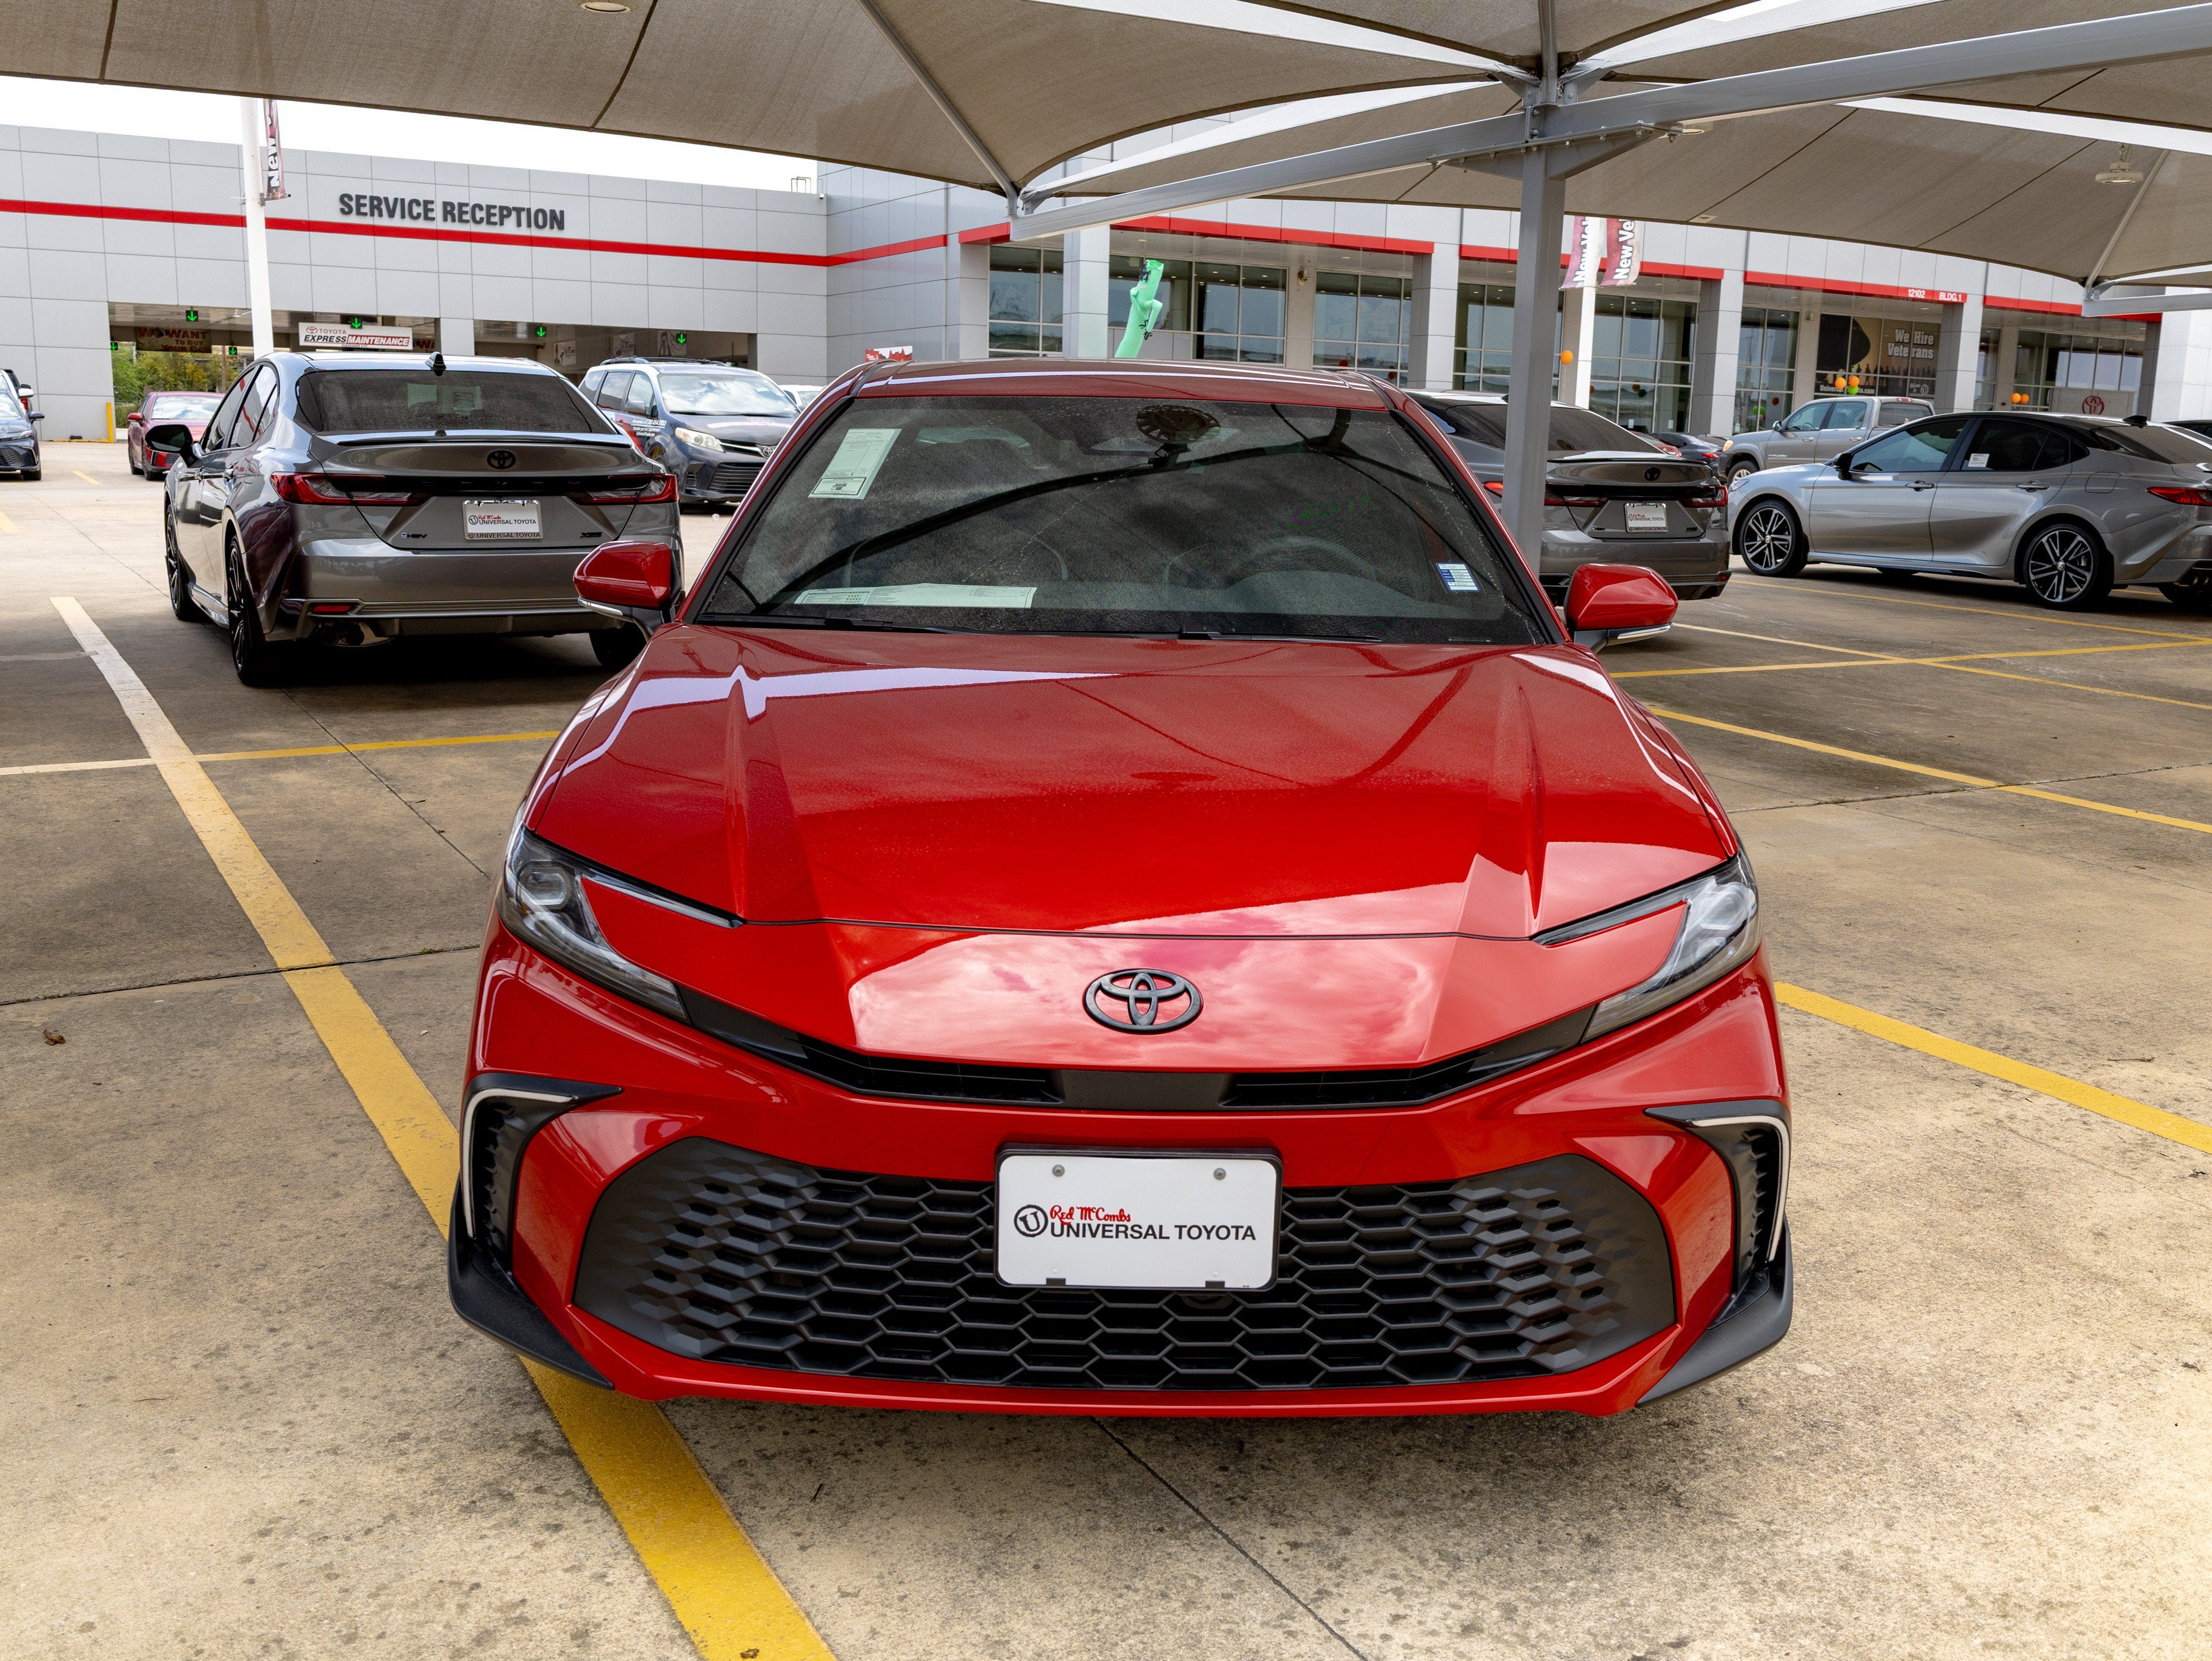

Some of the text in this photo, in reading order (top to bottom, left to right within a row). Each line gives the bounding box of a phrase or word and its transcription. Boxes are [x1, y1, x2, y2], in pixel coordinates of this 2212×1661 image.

[339, 193, 565, 230] SERVICE RECEPTION
[1613, 245, 1633, 279] New
[1908, 289, 1925, 298] 12102
[166, 328, 207, 339] WANT
[304, 335, 410, 346] EXPRESS MAINTENANCE
[1895, 329, 1934, 345] We Hire
[1888, 342, 1934, 359] Veterans
[1050, 1205, 1131, 1225] Red McCombs
[1050, 1222, 1256, 1241] UNIVERSAL TOYOTA
